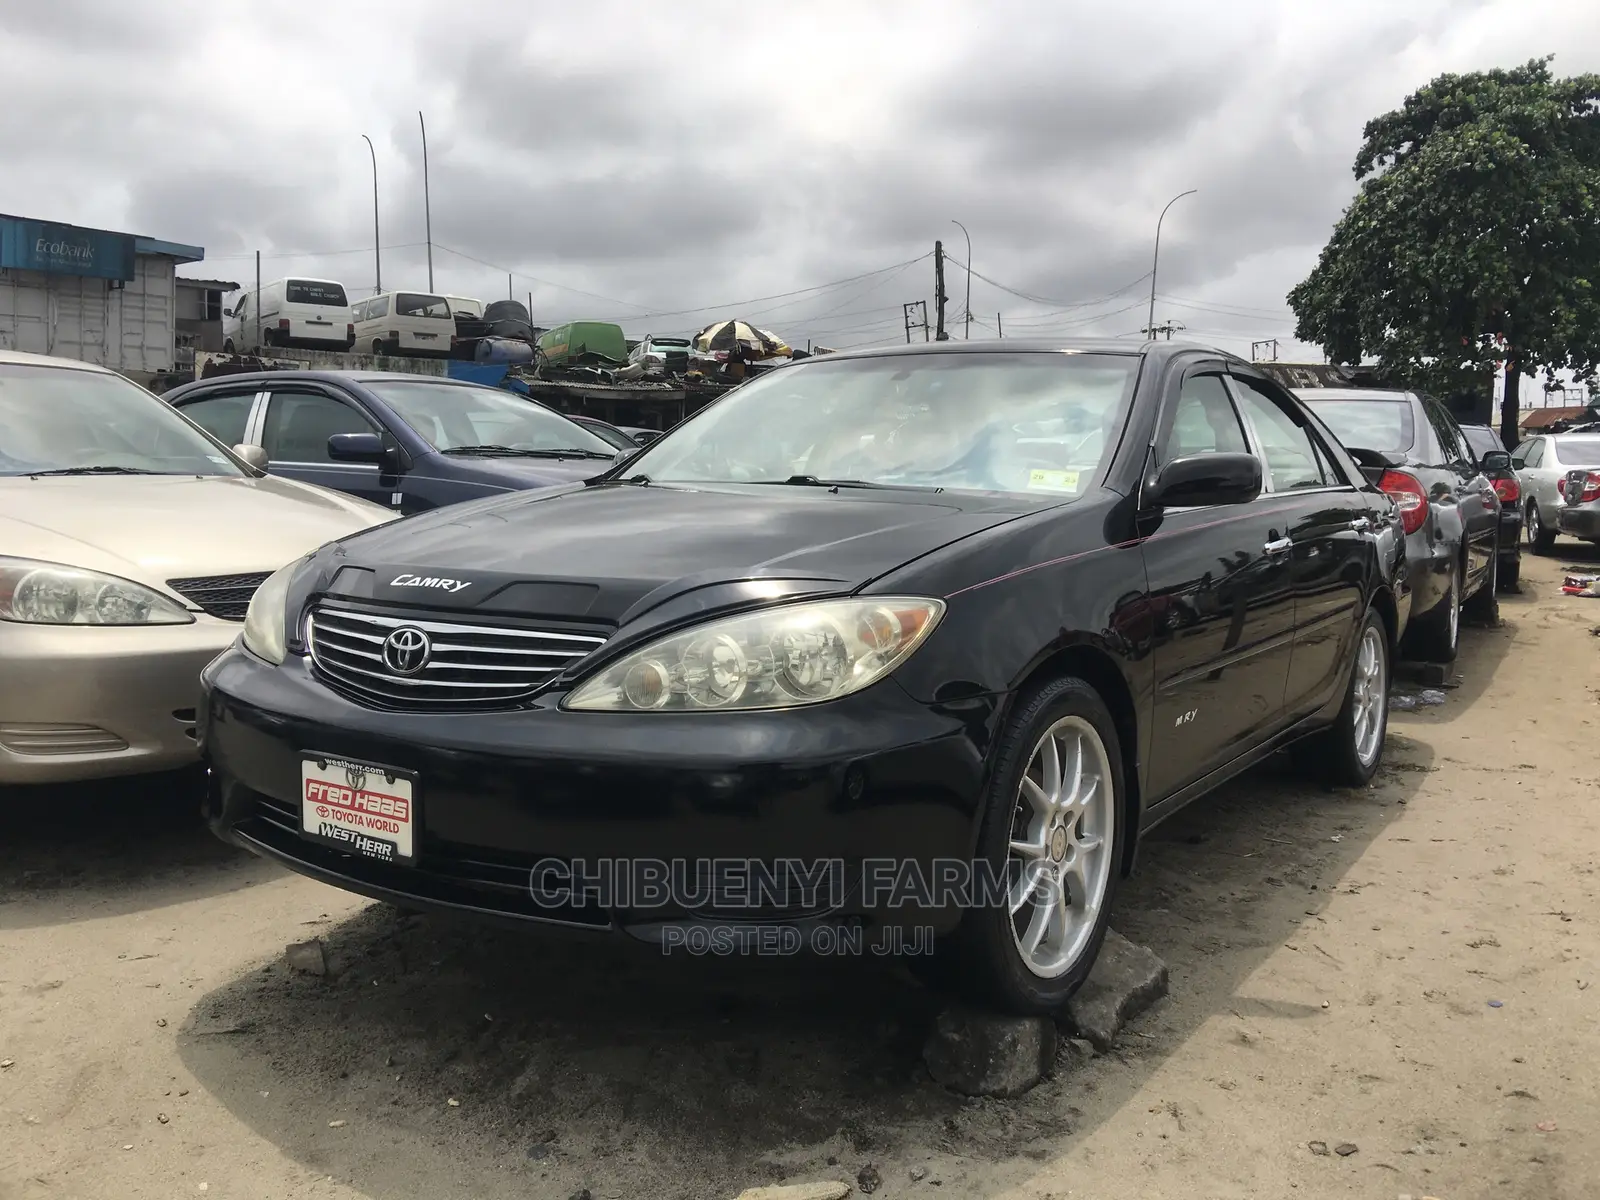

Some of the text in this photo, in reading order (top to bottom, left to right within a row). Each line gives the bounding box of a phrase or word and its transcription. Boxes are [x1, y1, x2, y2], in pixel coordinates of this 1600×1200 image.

[36, 238, 94, 258] Ecobank
[390, 574, 472, 592] CAMRY
[324, 758, 385, 775] westherr.com
[331, 809, 400, 834] TOYOTA WORLD
